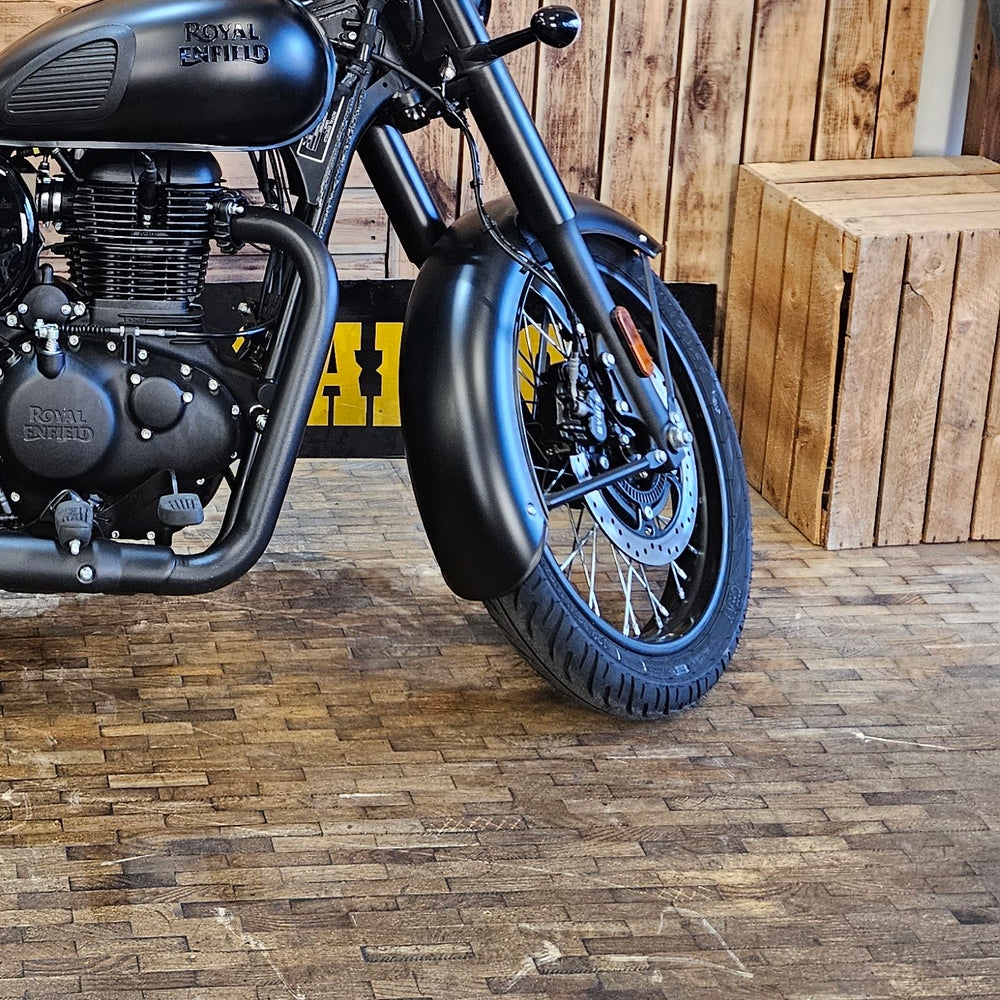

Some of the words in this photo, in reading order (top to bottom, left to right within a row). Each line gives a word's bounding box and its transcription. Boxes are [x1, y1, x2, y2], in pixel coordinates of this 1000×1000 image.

[183, 21, 261, 43] ROYAL
[178, 43, 271, 68] ENFIELD
[29, 405, 87, 425] ROYAL
[23, 424, 95, 443] ENFIELD
